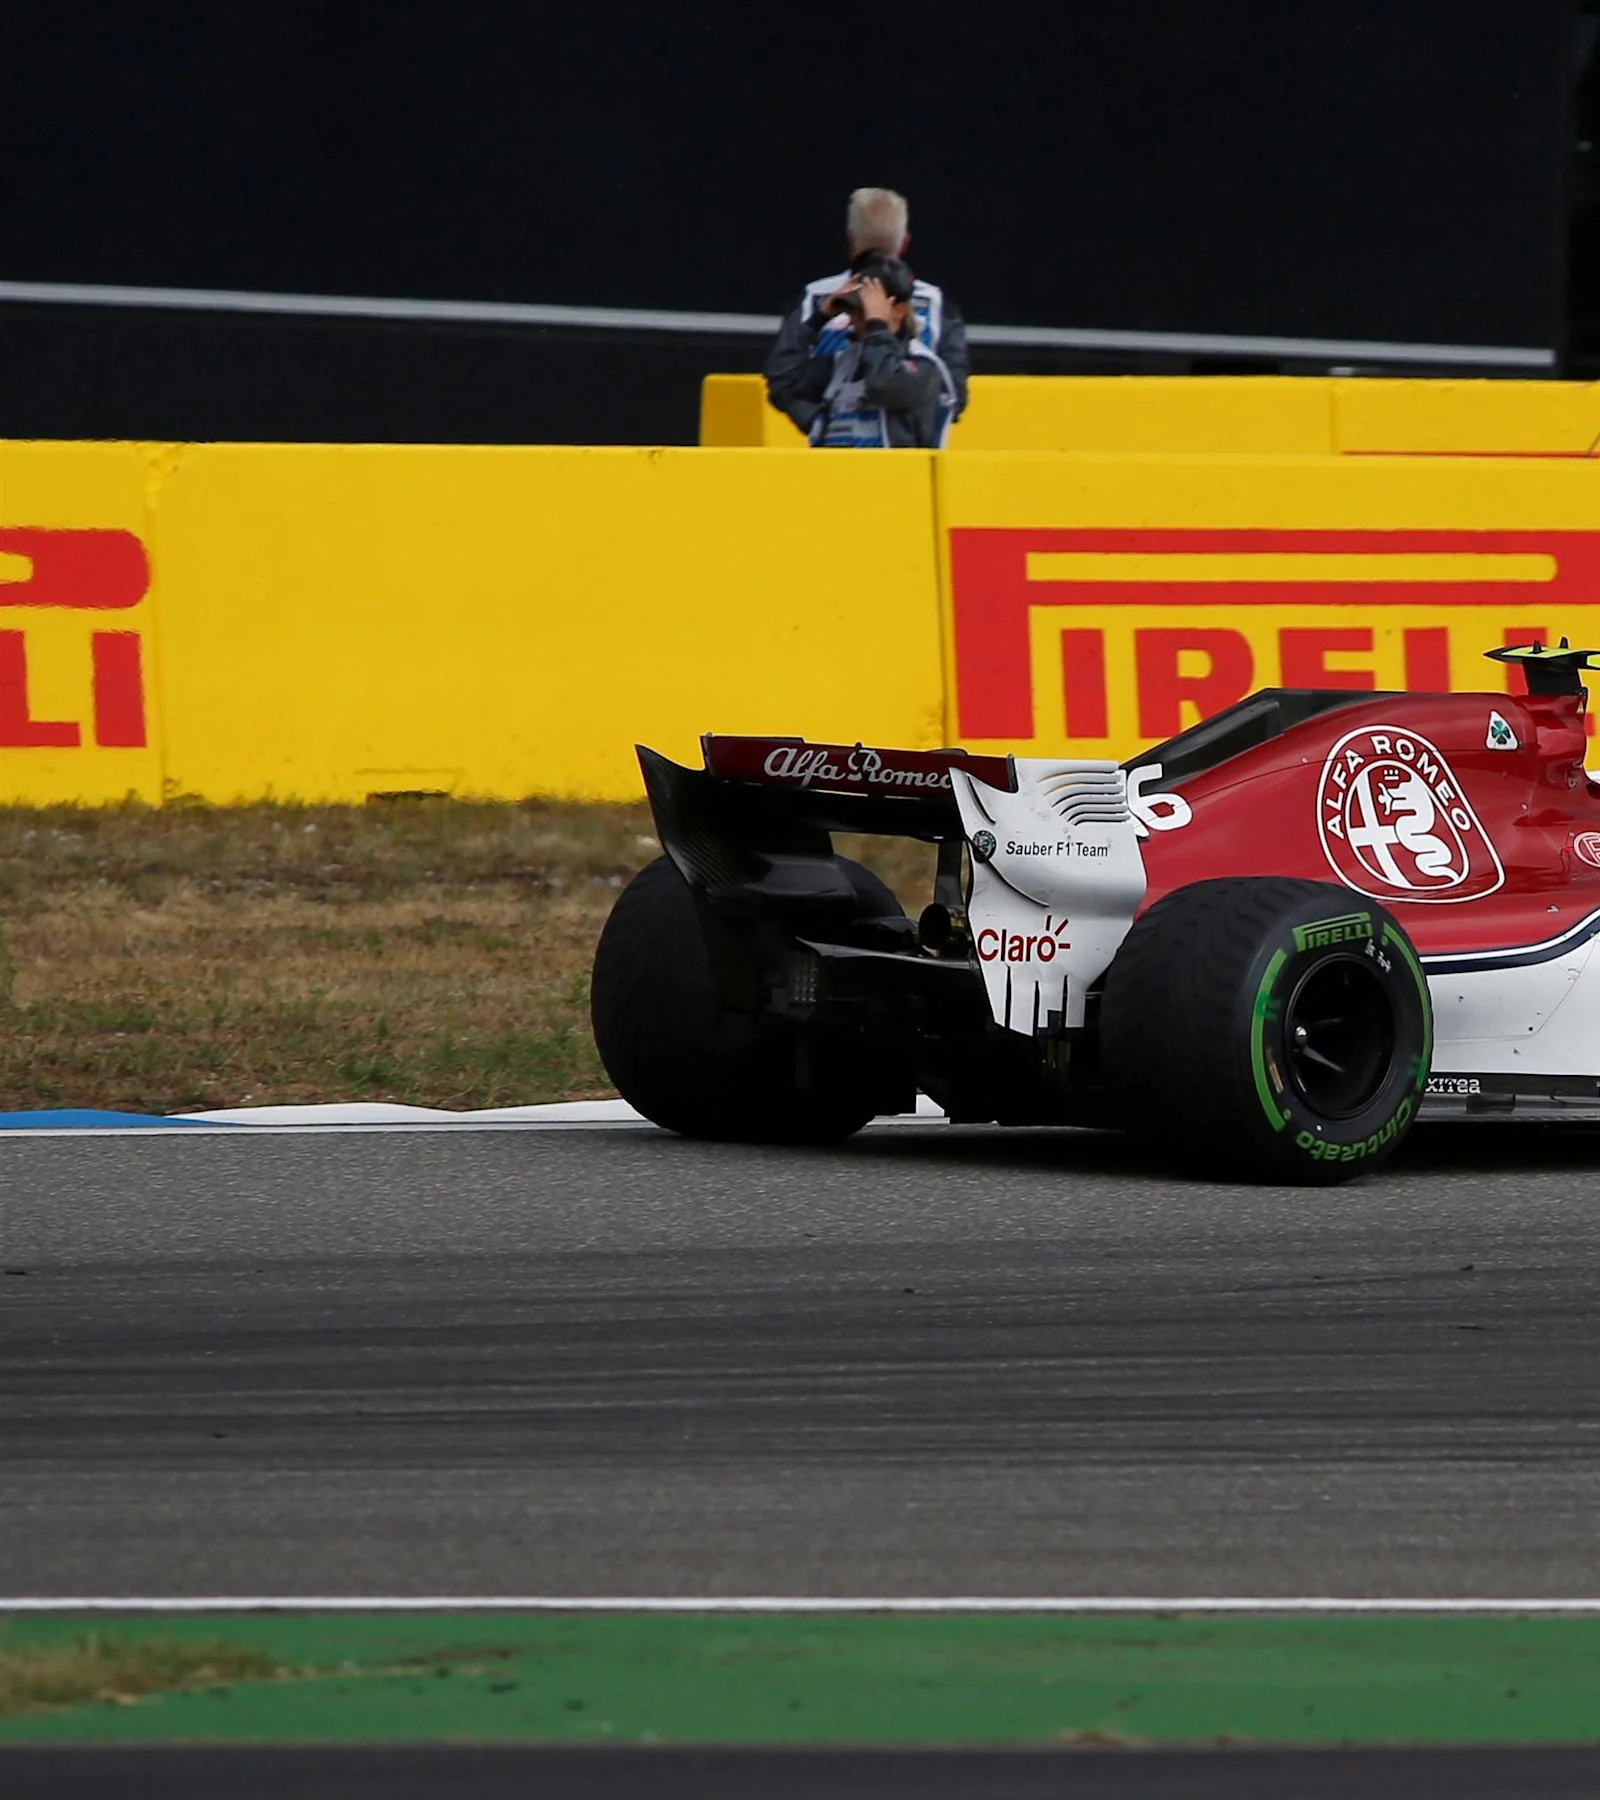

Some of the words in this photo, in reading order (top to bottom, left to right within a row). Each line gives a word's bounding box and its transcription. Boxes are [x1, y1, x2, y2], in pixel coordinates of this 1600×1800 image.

[763, 747, 846, 787] Alfa
[1326, 749, 1365, 840] ALFA
[1371, 735, 1472, 831] ROMEO
[1005, 841, 1053, 856] Sauber
[1056, 842, 1071, 857] F1
[1075, 842, 1109, 858] Team
[977, 926, 1058, 963] Claro
[1292, 911, 1374, 953] PIRELLI
[1296, 1097, 1413, 1162] Cinturato
